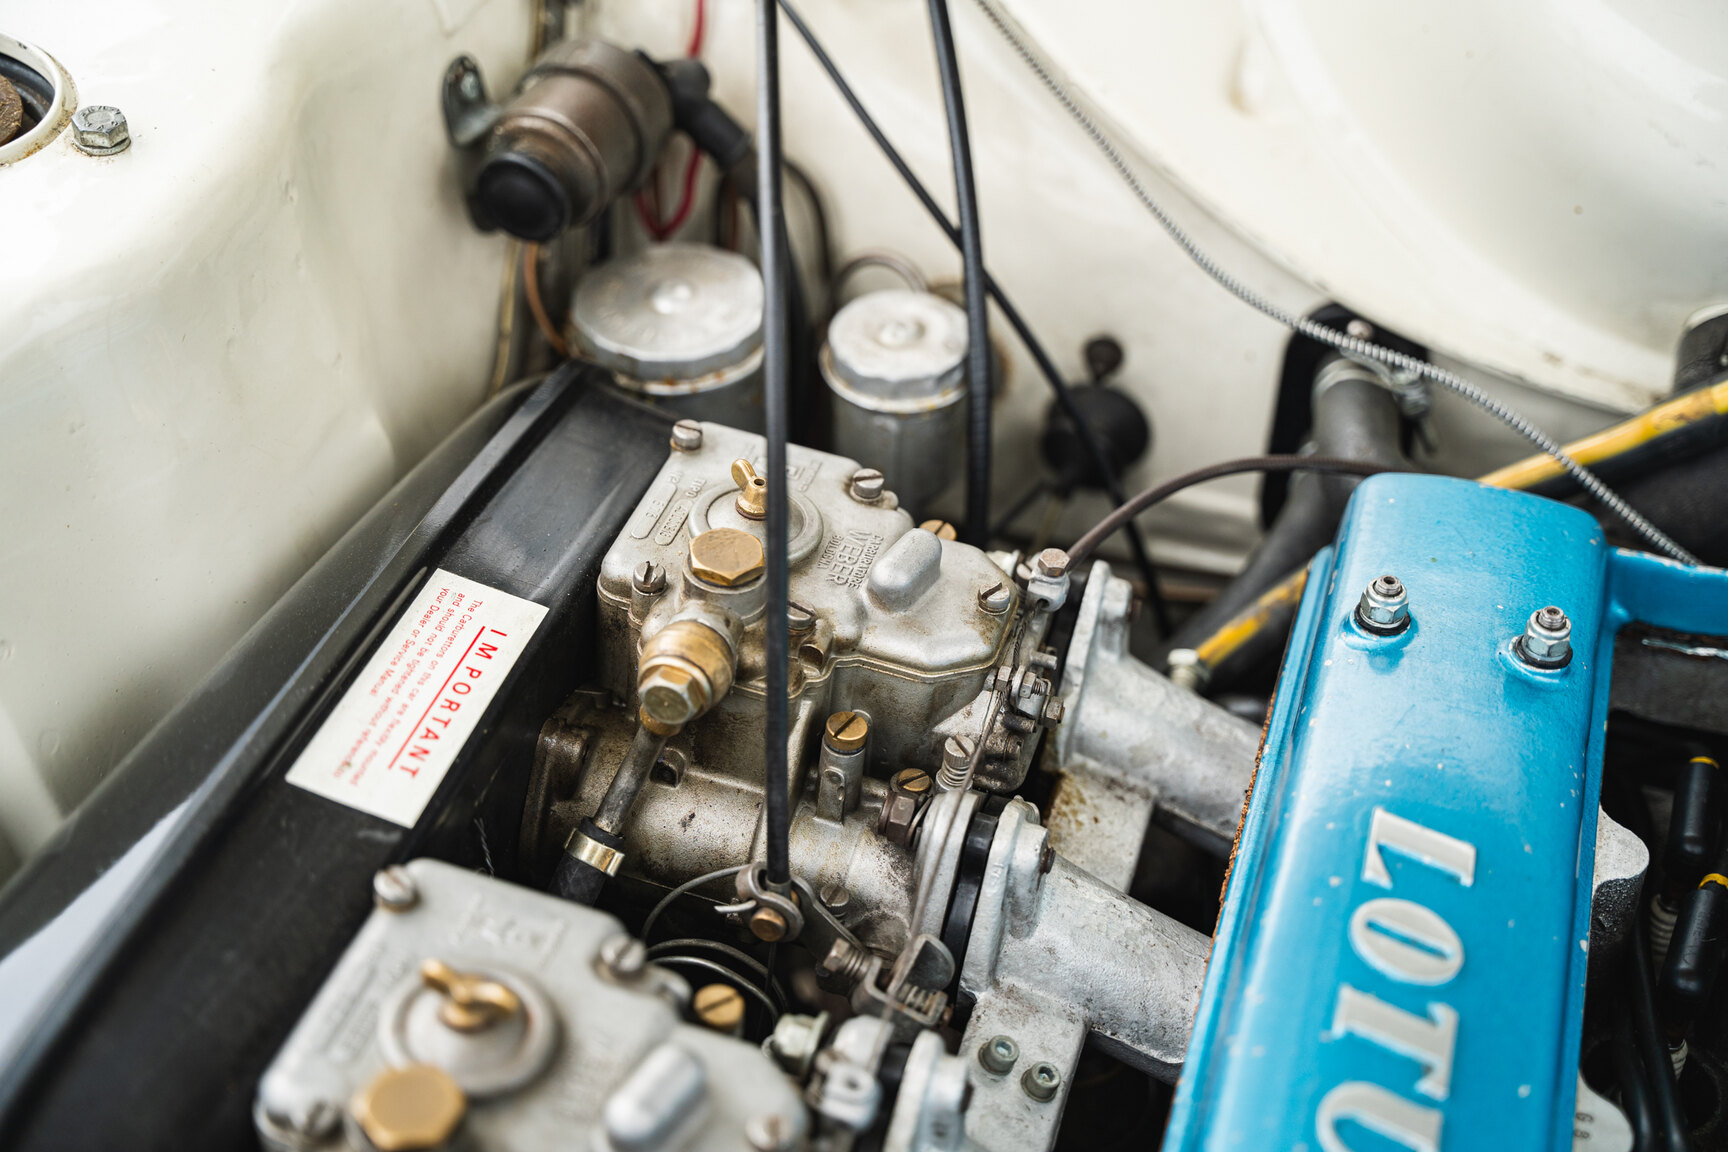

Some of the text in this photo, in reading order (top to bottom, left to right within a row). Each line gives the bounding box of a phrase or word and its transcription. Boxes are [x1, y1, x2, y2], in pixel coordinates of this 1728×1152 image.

[817, 535, 844, 569] BOLOGNA
[825, 530, 873, 585] WEBER
[436, 588, 449, 604] your
[452, 593, 465, 607] and
[468, 600, 483, 612] The
[419, 605, 440, 627] Dealer
[435, 608, 454, 631] should
[411, 629, 420, 638] or
[424, 633, 437, 645] not
[436, 614, 472, 658] Carburettors
[390, 639, 415, 666] Service
[417, 648, 428, 657] be
[429, 660, 439, 670] on
[392, 660, 420, 695] tightened
[417, 673, 431, 685] this
[408, 688, 419, 700] car
[397, 704, 408, 716] are
[400, 629, 507, 777] IMPORTANT
[369, 696, 392, 727] without
